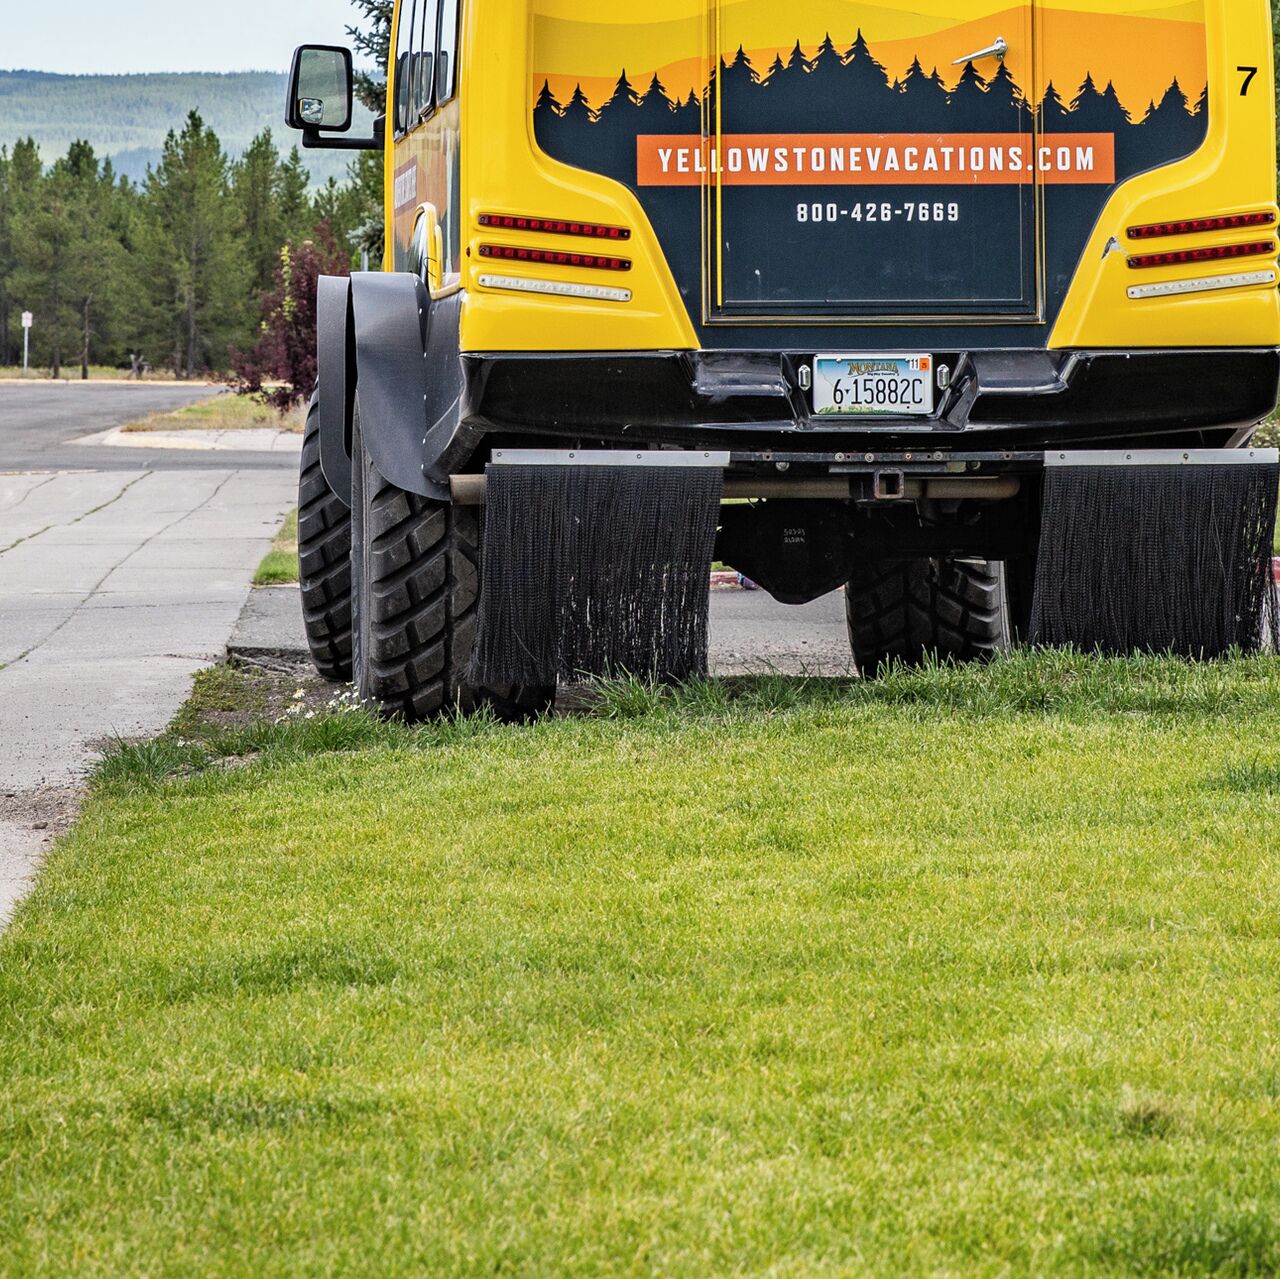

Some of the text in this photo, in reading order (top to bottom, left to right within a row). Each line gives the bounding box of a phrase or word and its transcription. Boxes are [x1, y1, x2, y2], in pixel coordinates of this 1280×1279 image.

[1236, 66, 1258, 96] 7
[657, 146, 1095, 172] YELLOWSTONEVACATIONS.COM
[796, 202, 959, 223] 800-426-7669
[848, 361, 899, 376] MONTANA
